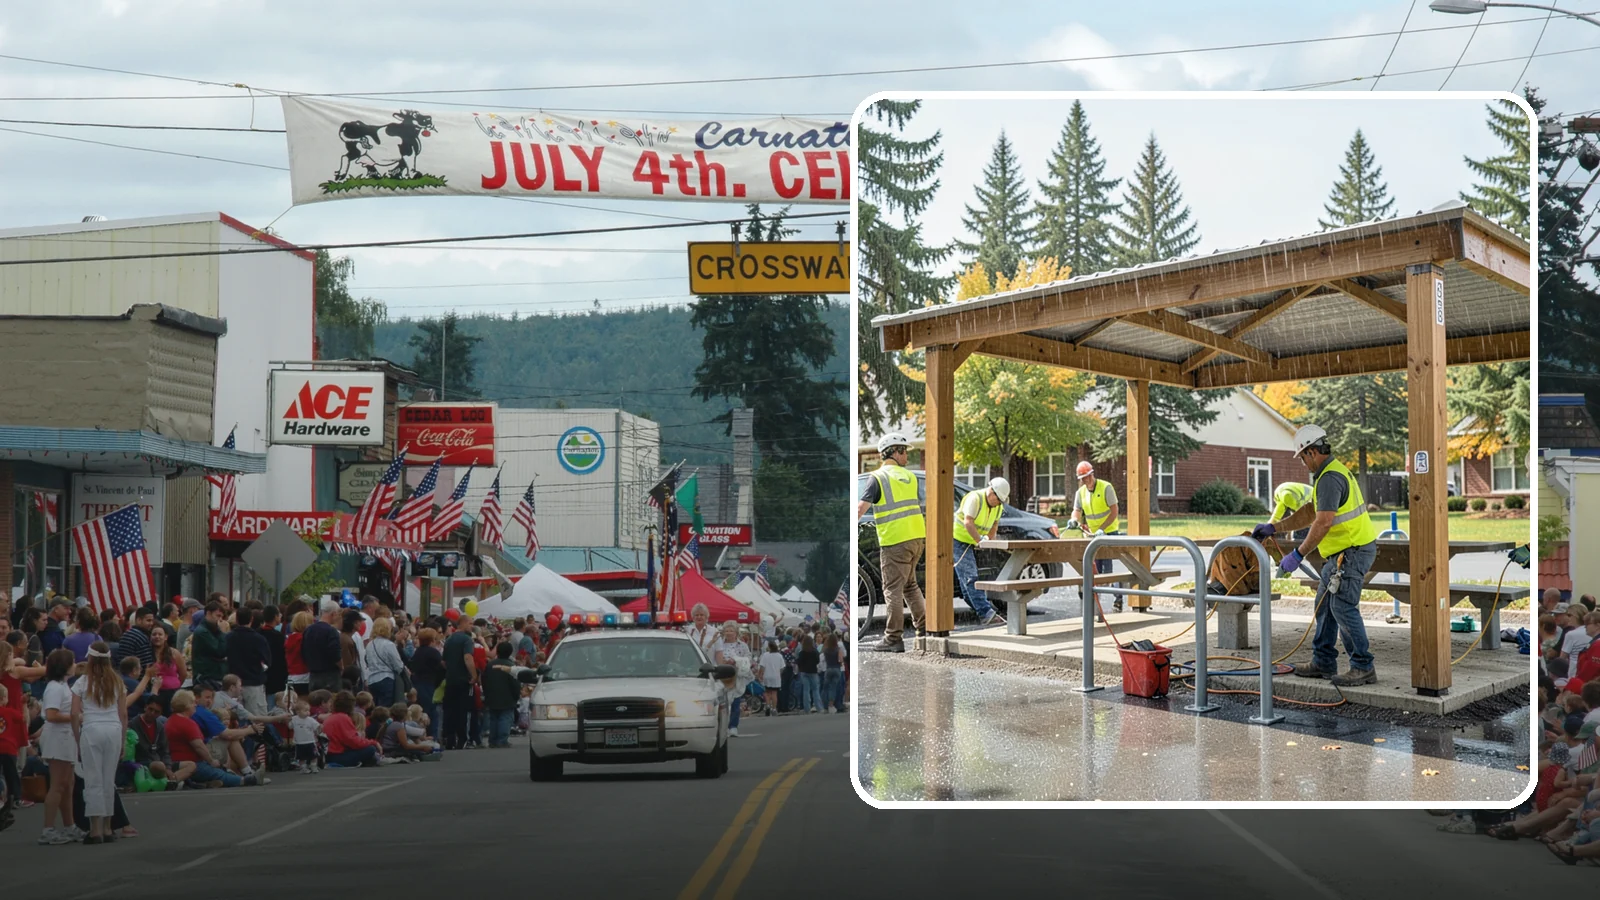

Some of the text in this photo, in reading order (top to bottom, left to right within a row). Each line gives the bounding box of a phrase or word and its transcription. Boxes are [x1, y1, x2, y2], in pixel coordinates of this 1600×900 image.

[481, 140, 605, 192] JULY
[632, 150, 747, 198] 4th.
[696, 254, 850, 280] CROSSWA
[282, 380, 373, 420] ACE
[405, 409, 453, 422] CEDAR
[283, 421, 371, 436] Hardware
[83, 485, 155, 495] St. Vincent de Paul
[688, 526, 742, 535] CRNATION
[699, 535, 730, 544] GLASS
